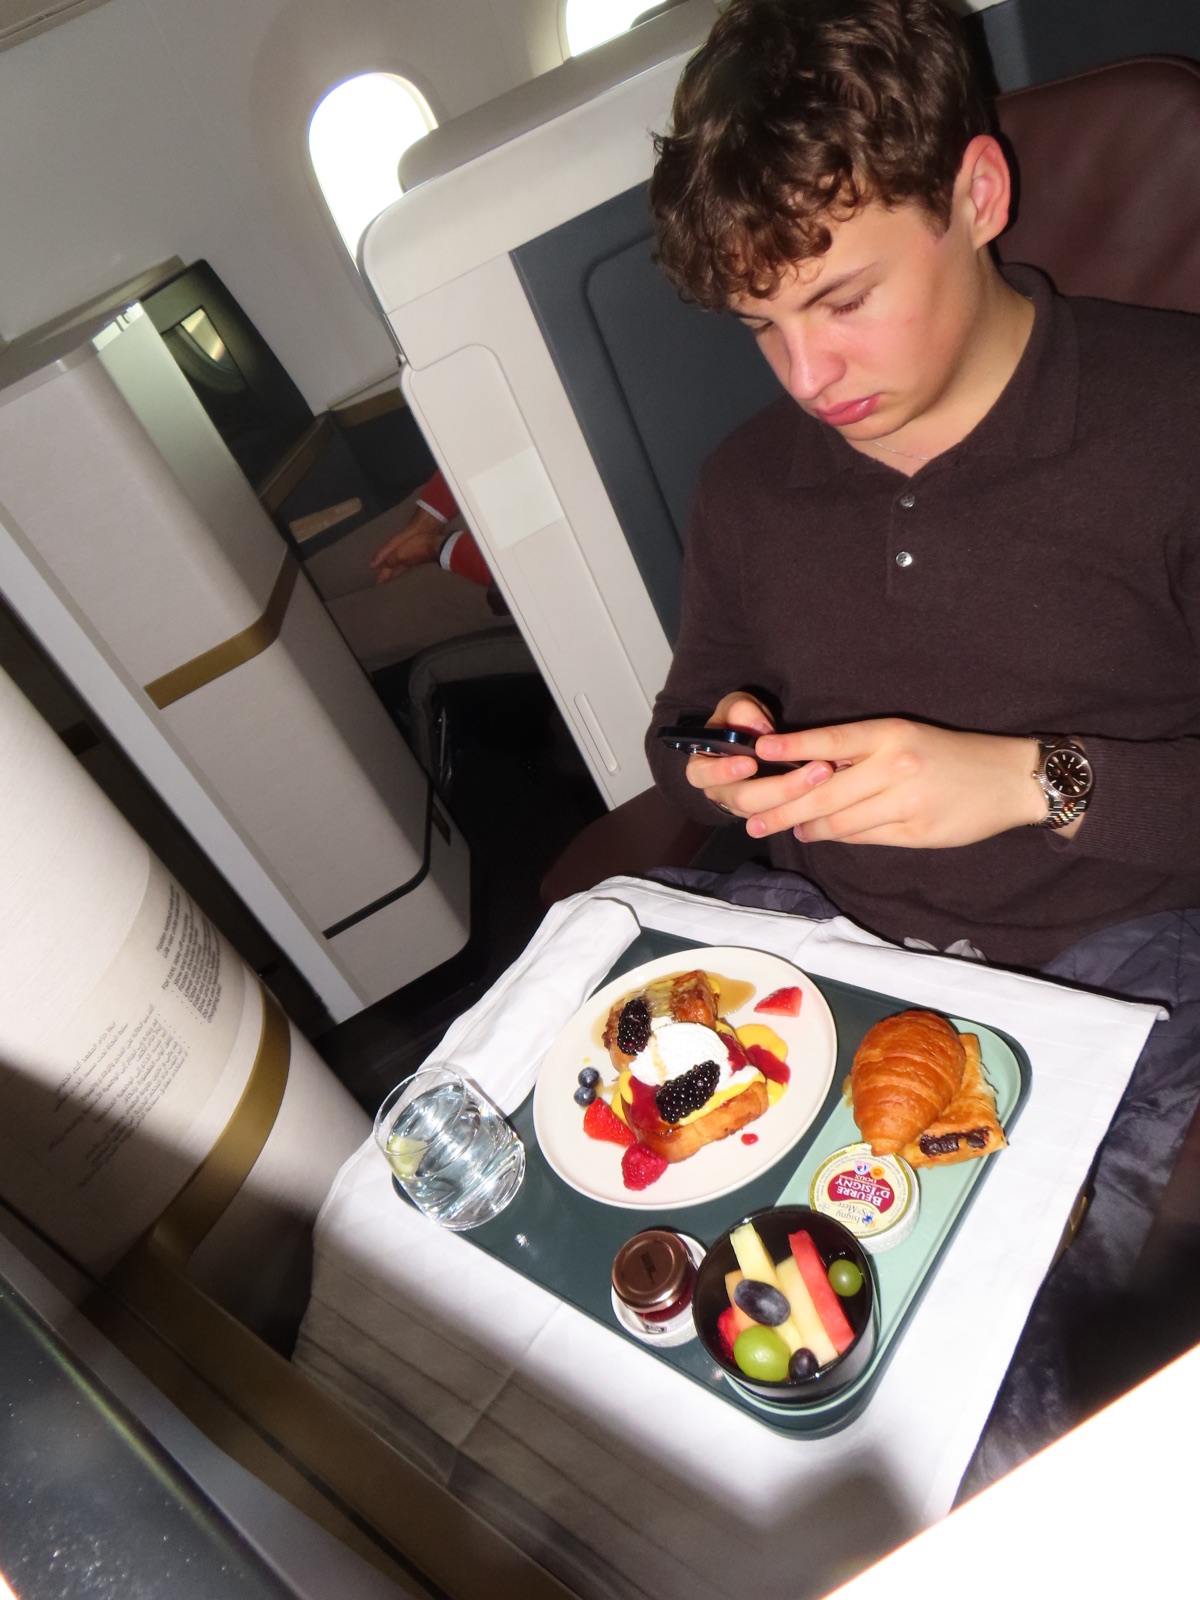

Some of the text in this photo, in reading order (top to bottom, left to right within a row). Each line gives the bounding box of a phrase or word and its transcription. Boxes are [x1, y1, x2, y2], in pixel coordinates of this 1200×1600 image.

[160, 978, 170, 990] For
[836, 1186, 882, 1207] BEURRE
[835, 1209, 861, 1224] Isigny
